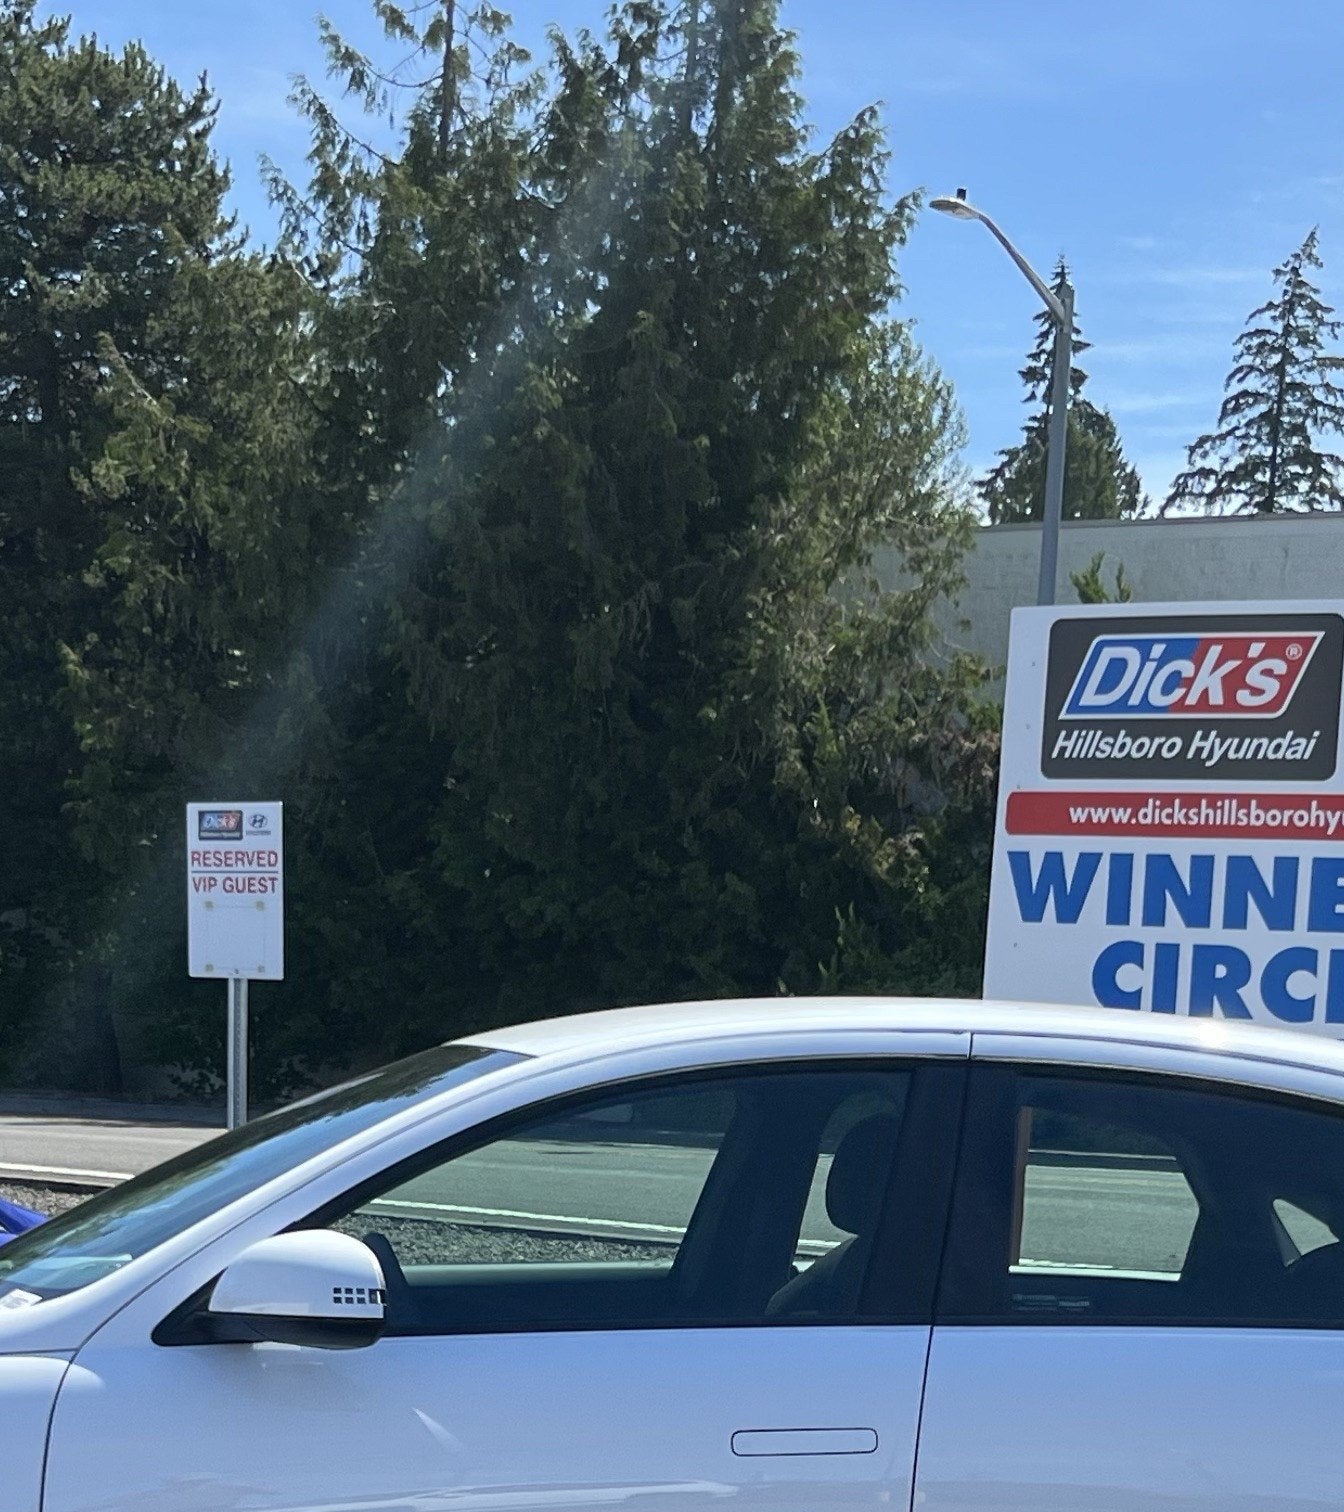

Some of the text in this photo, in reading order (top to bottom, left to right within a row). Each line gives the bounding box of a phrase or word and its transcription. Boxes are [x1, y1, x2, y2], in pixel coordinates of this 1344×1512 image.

[1078, 642, 1289, 707] Dick's
[1051, 729, 1322, 768] Hillsboro Hyundai
[190, 850, 279, 868] RESERVED
[192, 876, 279, 894] VIP GUEST
